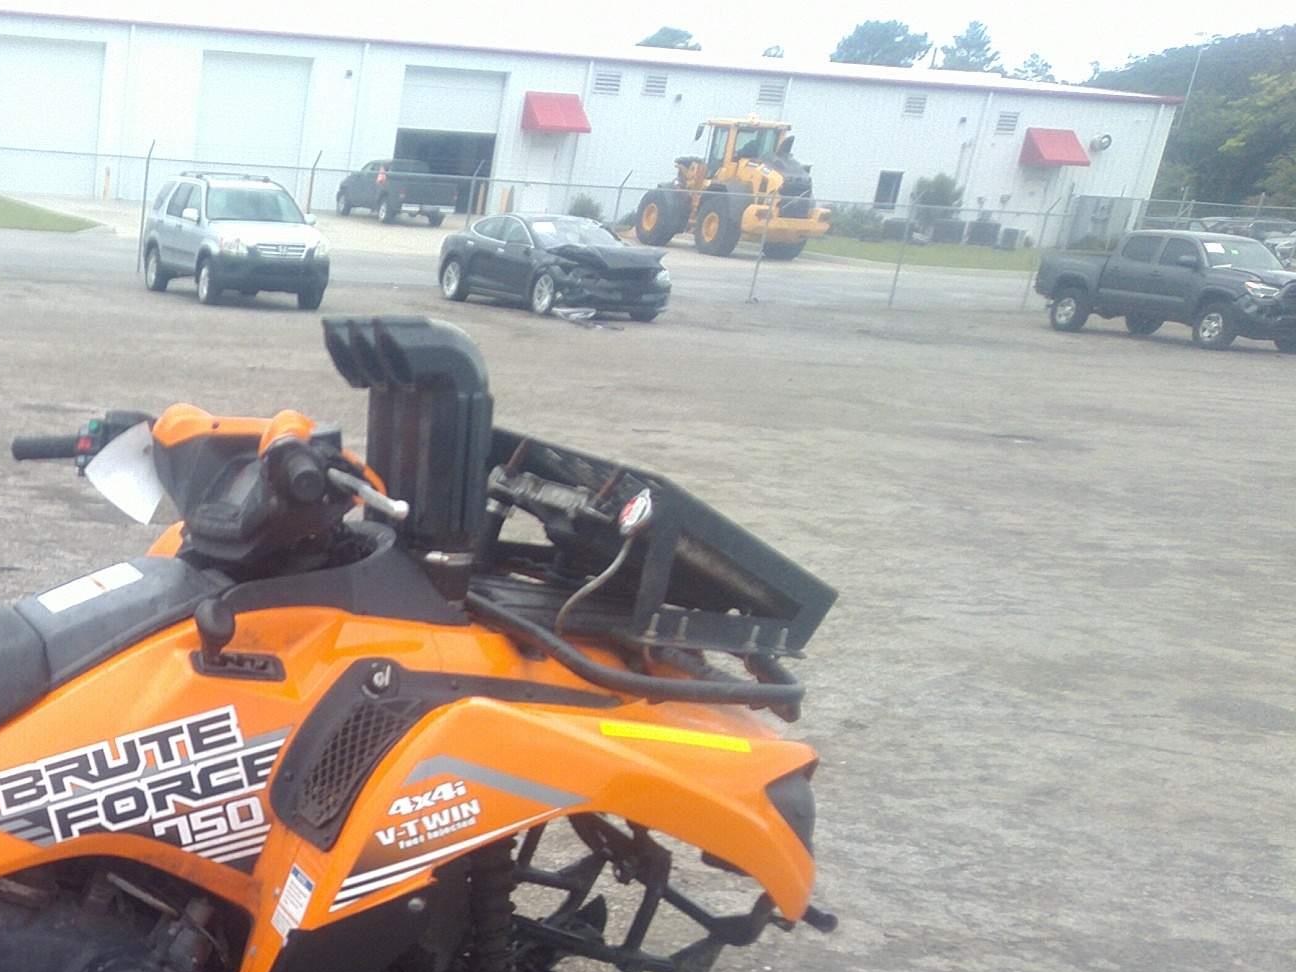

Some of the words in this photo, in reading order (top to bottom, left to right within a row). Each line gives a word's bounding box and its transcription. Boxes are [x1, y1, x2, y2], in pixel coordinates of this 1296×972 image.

[50, 746, 280, 842] FORCE
[388, 780, 467, 816] 4x4i
[153, 797, 265, 846] 750
[375, 799, 481, 846] V-TWIN
